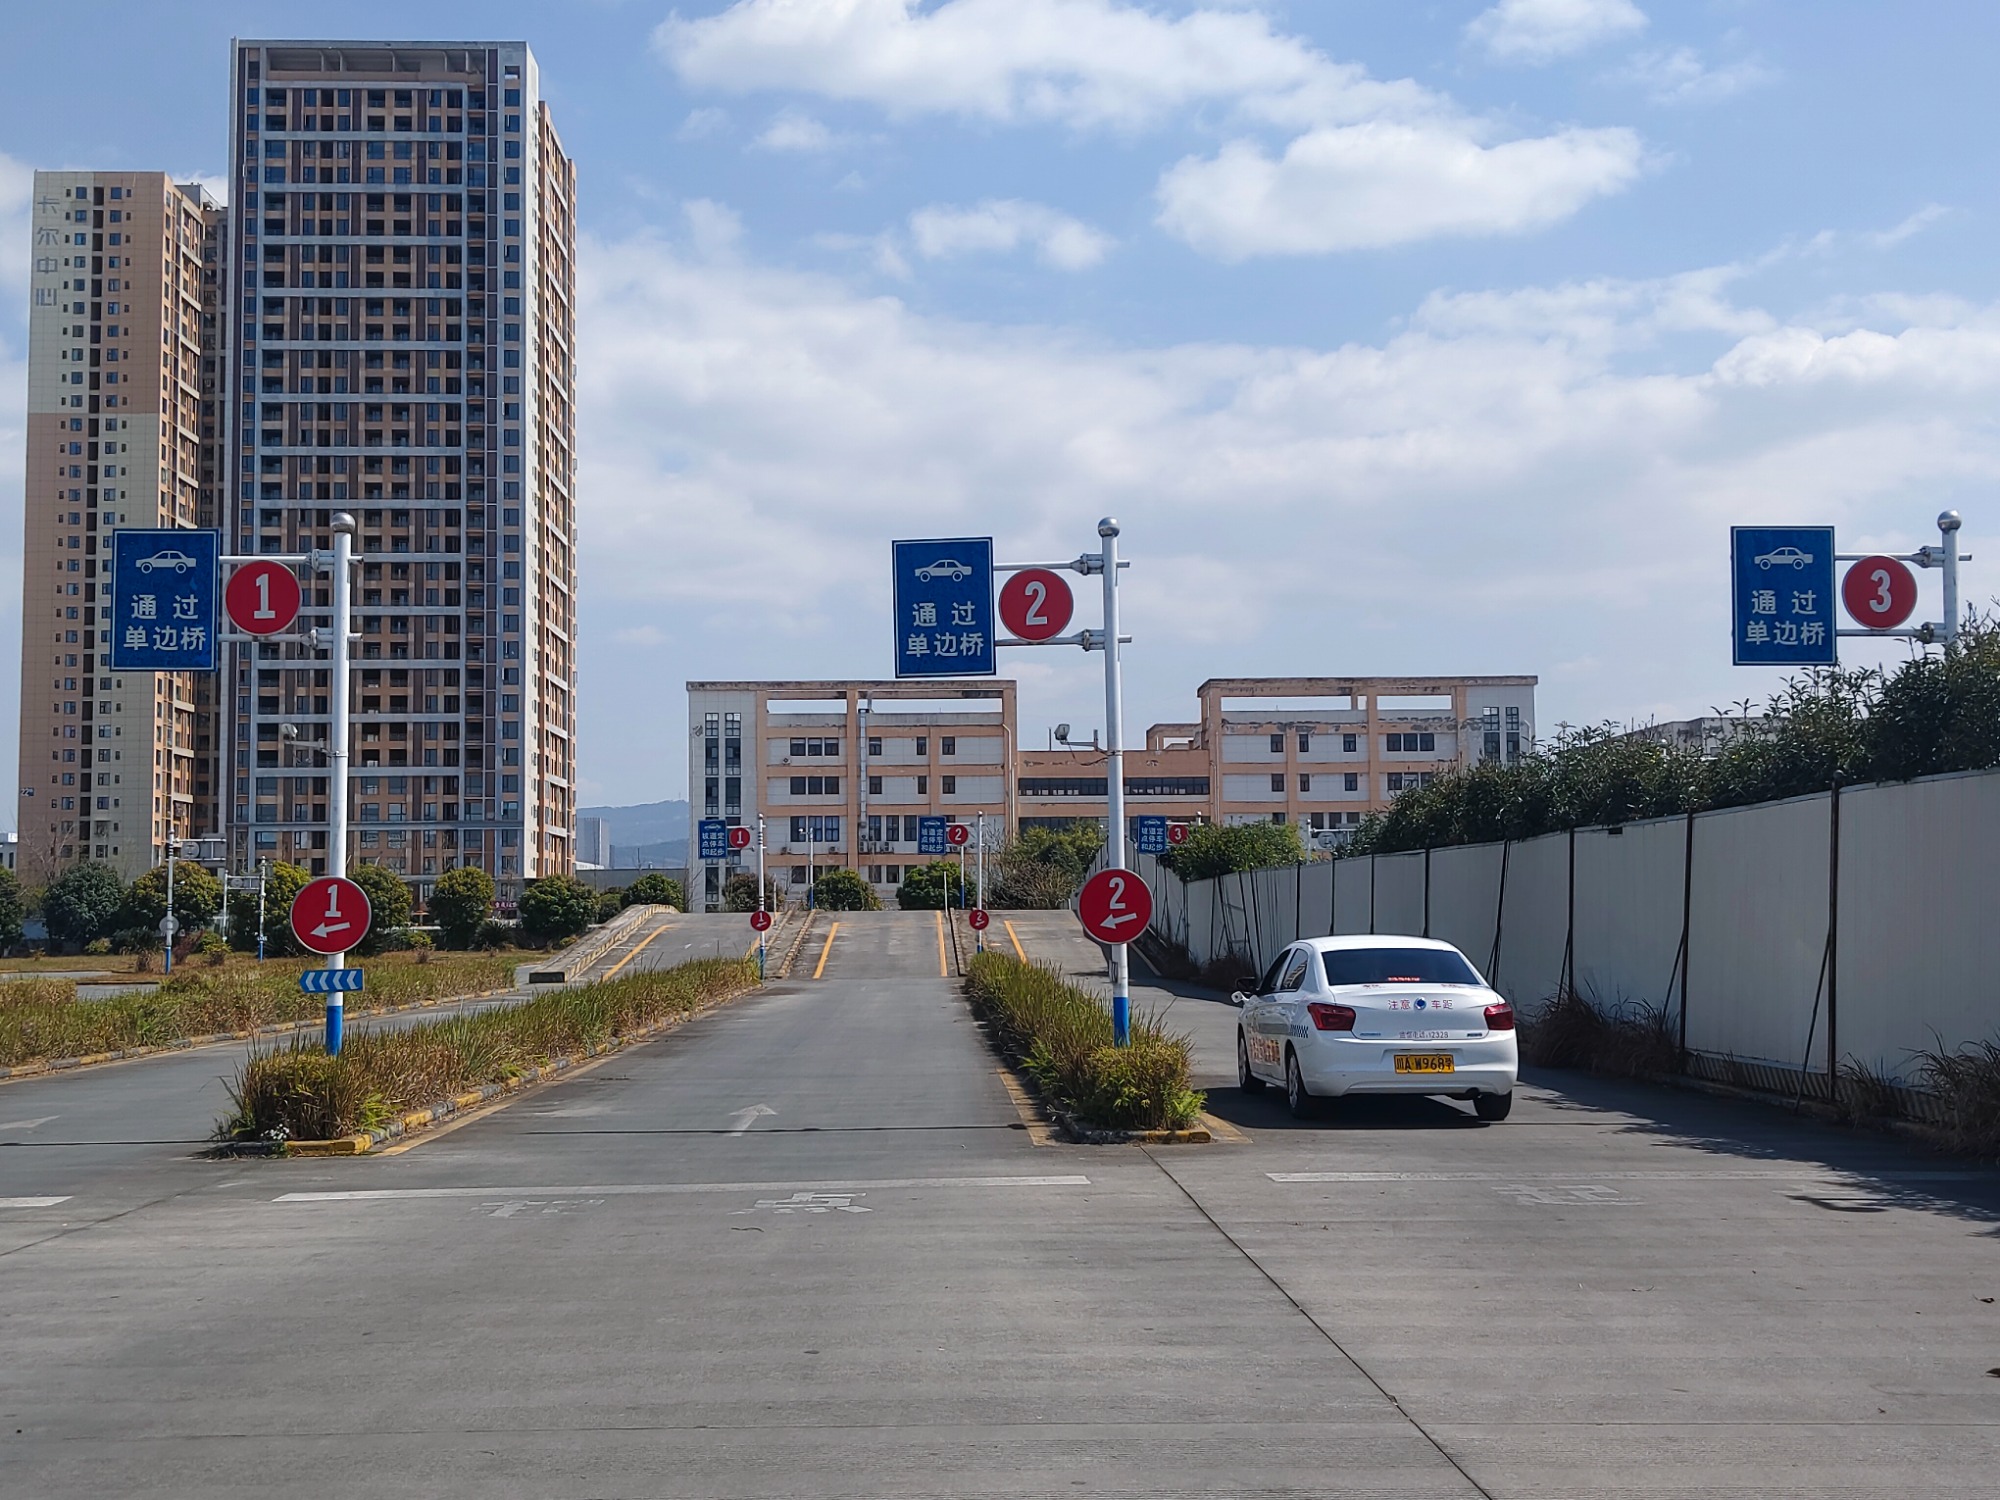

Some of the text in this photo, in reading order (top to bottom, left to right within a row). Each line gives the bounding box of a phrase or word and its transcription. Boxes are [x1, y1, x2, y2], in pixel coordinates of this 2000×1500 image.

[36, 195, 60, 307] 卡尔中心
[253, 573, 276, 620] 1
[1024, 580, 1048, 626] 2
[1751, 589, 1817, 616] 通过
[1869, 569, 1892, 613] 3
[131, 594, 199, 621] 通过
[912, 601, 976, 627] 通过
[123, 625, 207, 652] 单边桥
[906, 632, 984, 658] 单边桥
[1745, 620, 1826, 647] 单边桥
[736, 831, 744, 844] 1
[954, 828, 962, 841] 2
[1174, 828, 1182, 840] 3
[325, 884, 342, 918] 1
[1109, 877, 1126, 910] 2
[758, 912, 764, 922] 1
[976, 912, 983, 922] 2
[1388, 999, 1454, 1010] 注意 车距
